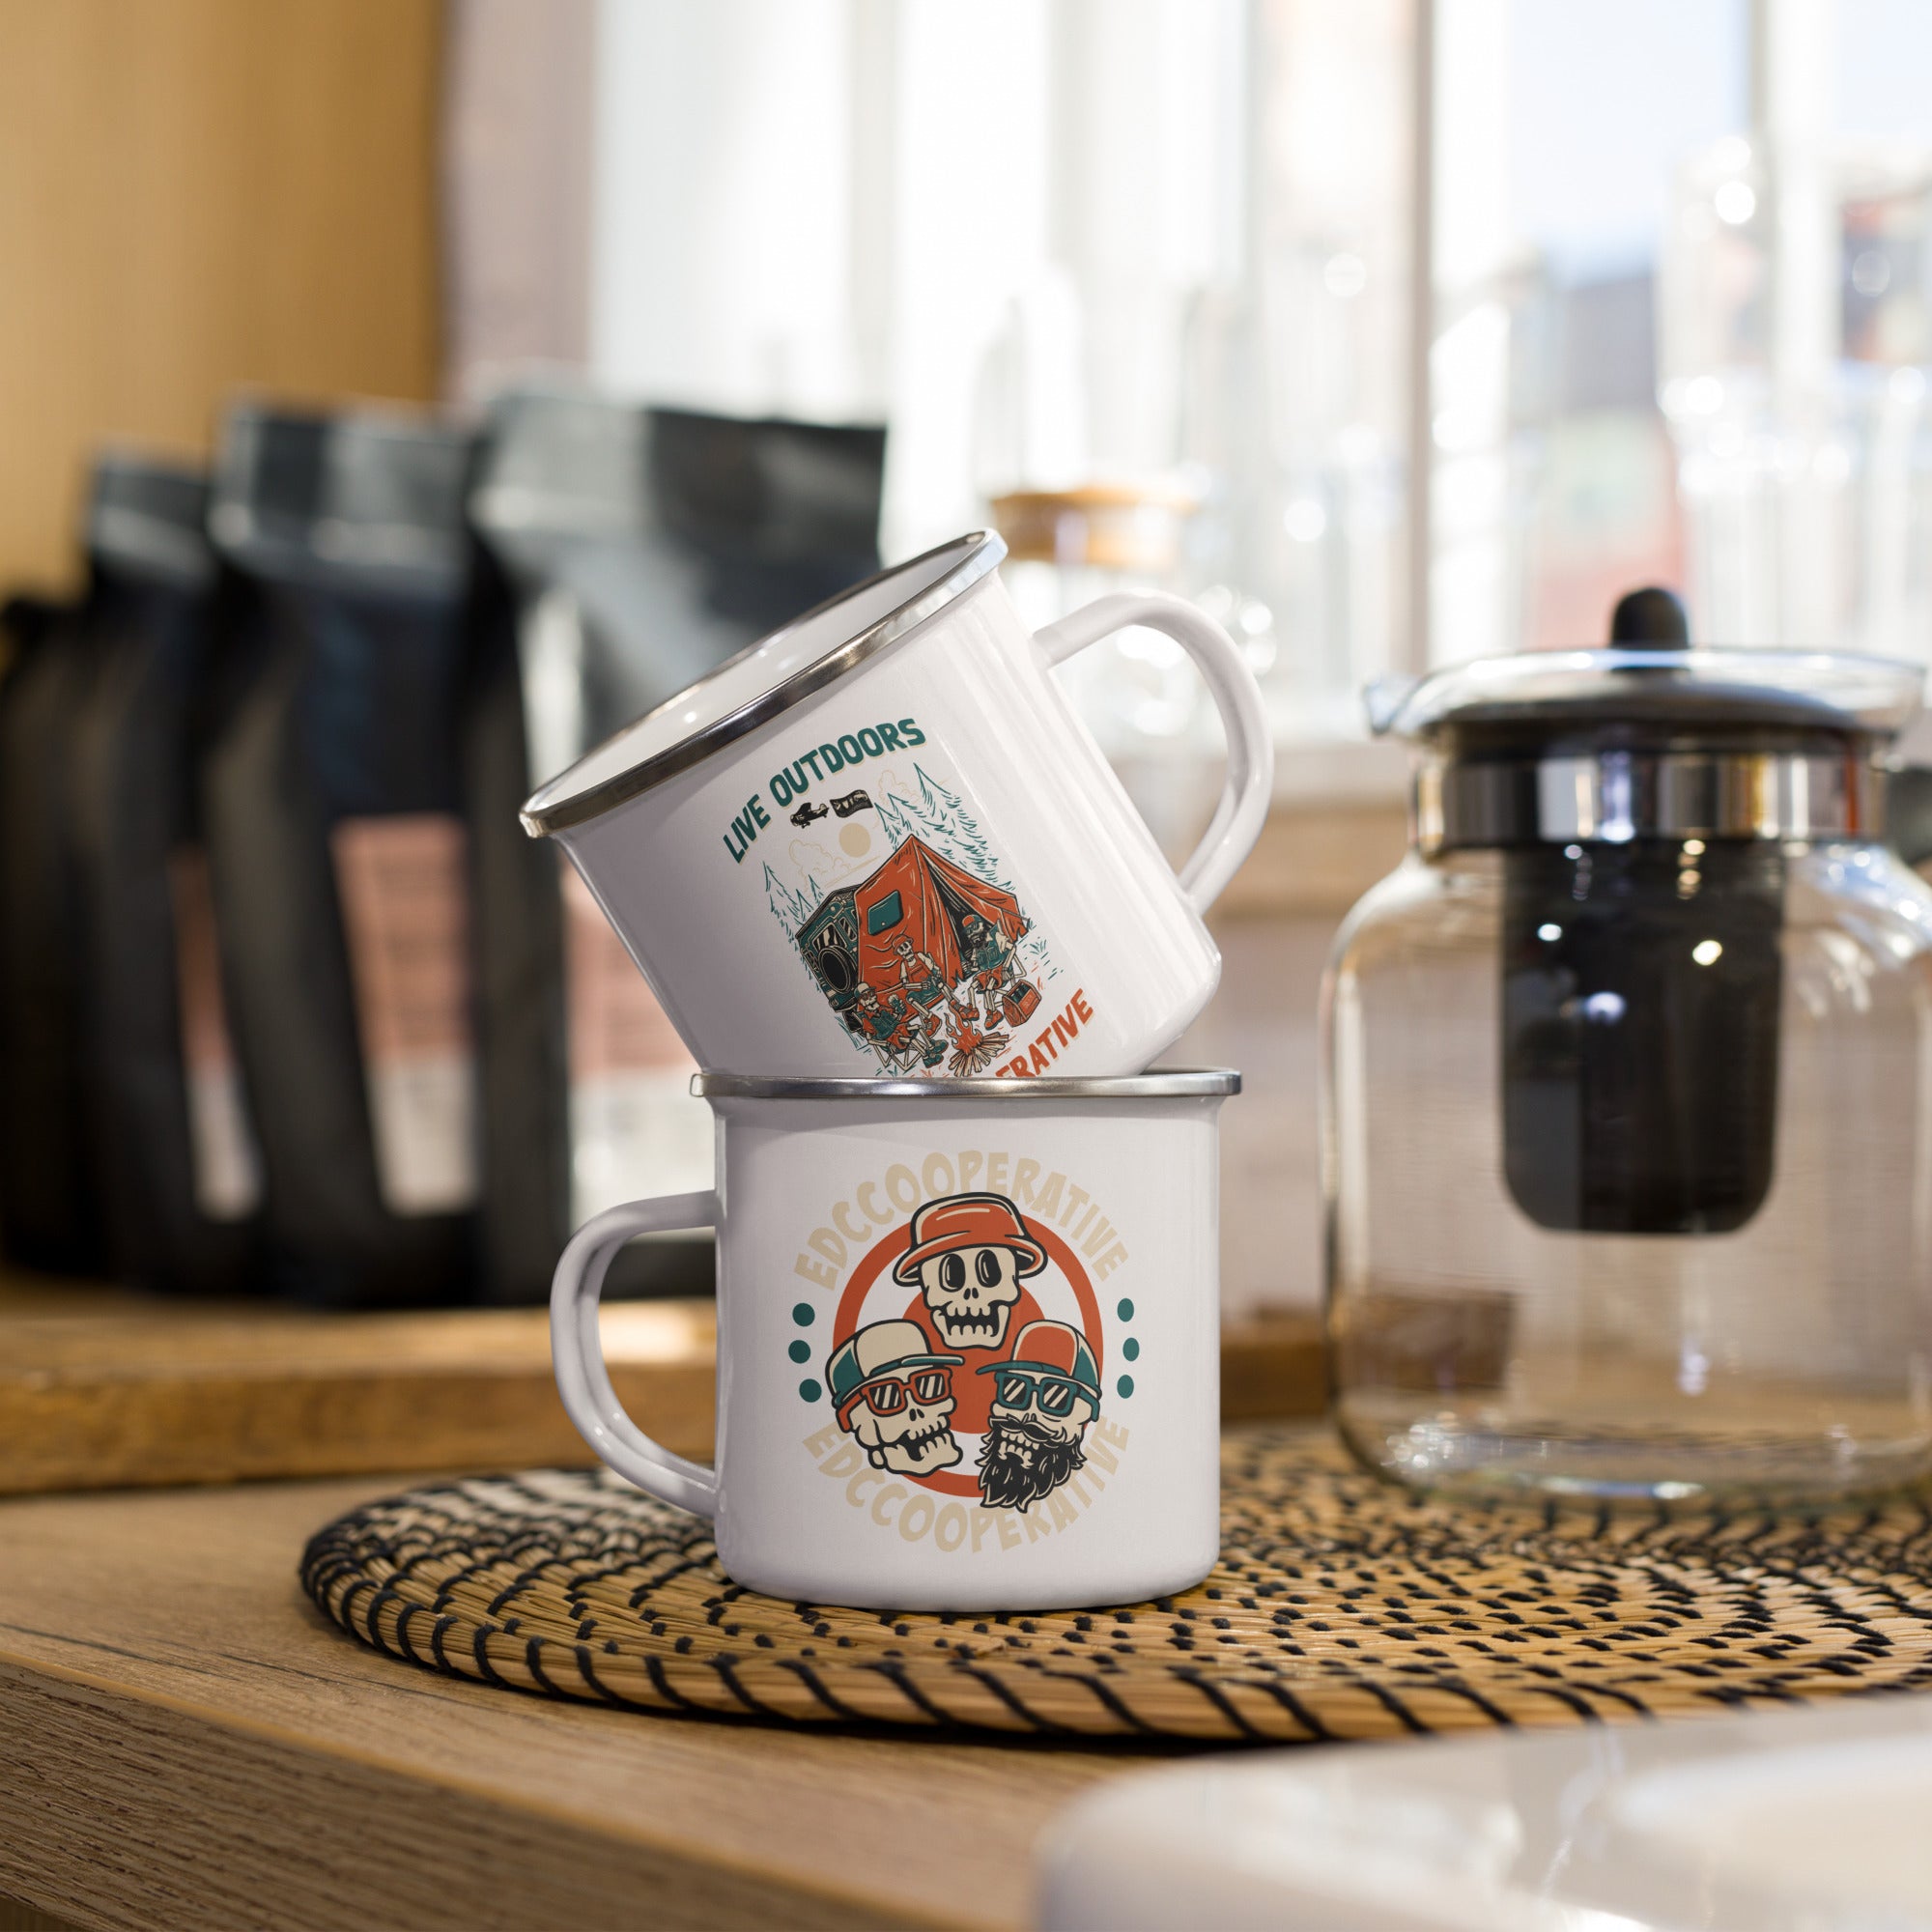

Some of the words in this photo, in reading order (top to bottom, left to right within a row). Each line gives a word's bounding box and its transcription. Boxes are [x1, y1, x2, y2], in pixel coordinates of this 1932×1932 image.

[724, 794, 771, 865] LIVE
[769, 718, 927, 808] OUTDOORS
[794, 1150, 1128, 1291] EDCCOOPERATIVE
[803, 1415, 1129, 1553] EDCCOOPERATIVE
